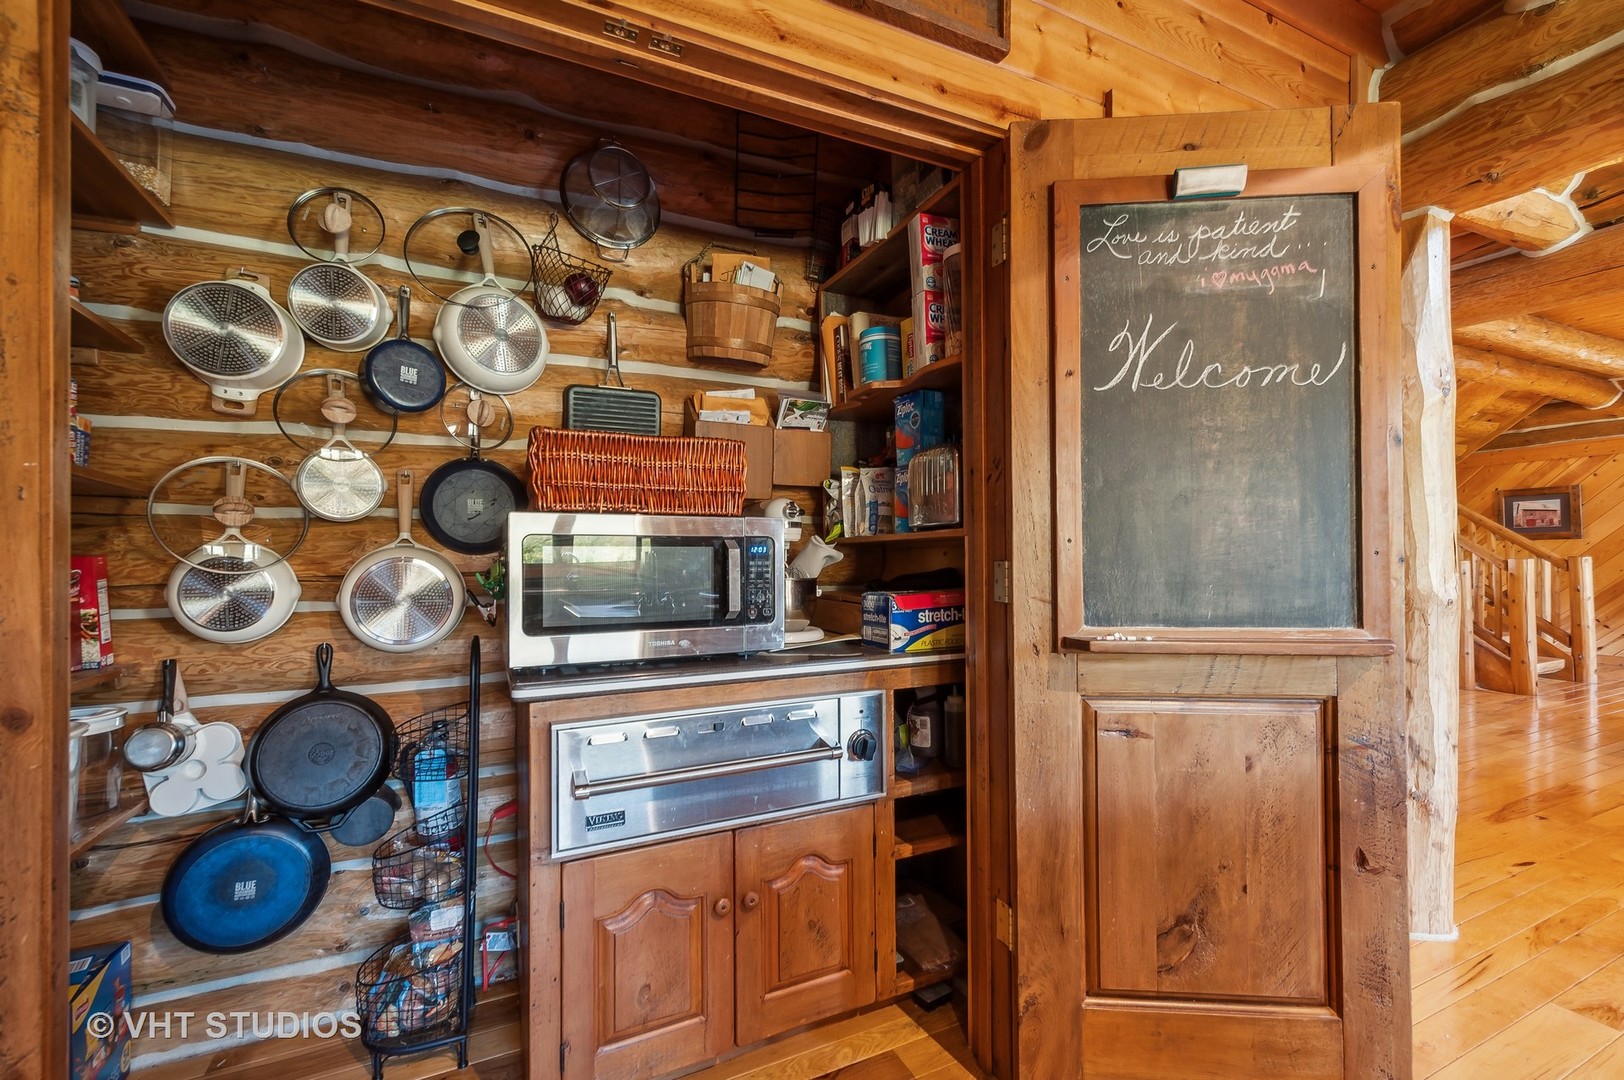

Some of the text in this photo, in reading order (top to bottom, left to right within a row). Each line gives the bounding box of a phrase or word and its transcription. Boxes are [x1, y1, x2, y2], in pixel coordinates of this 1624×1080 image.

[925, 226, 958, 239] CREAM
[1087, 205, 1302, 259] Love is patient
[1137, 236, 1191, 265] and
[1094, 314, 1347, 392] Welcome
[400, 365, 418, 375] BLUE
[896, 401, 915, 418] Ziploc
[467, 498, 484, 507] BLUE
[750, 546, 767, 554] 12:03
[921, 639, 945, 647] PLASTIC
[588, 811, 624, 826] VIKING
[235, 880, 257, 891] BLUE
